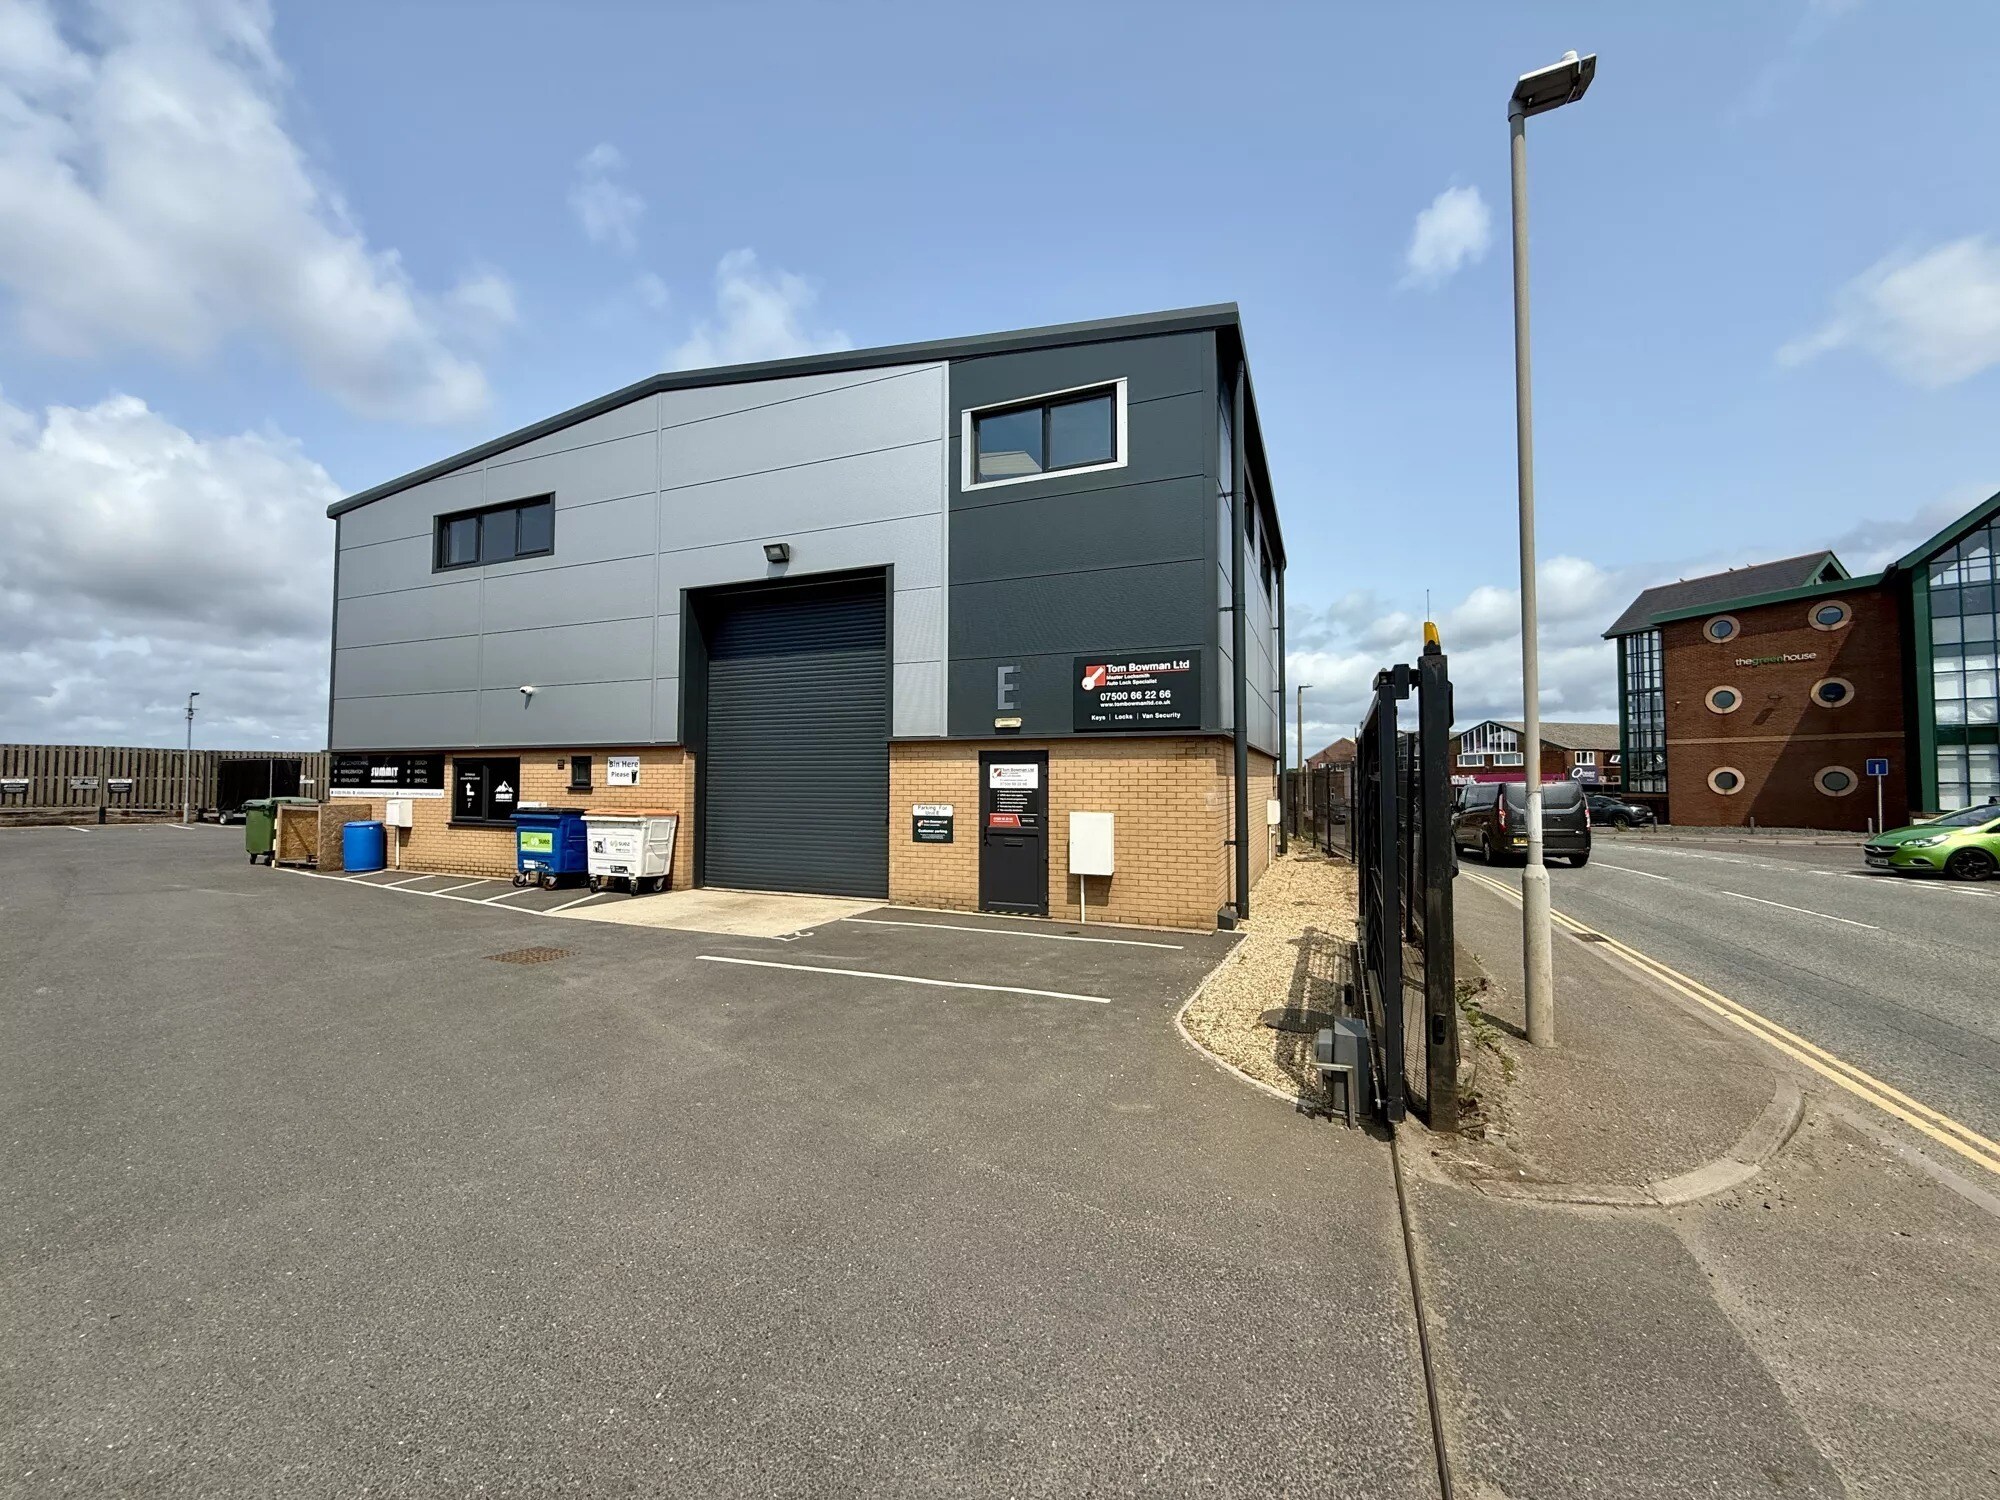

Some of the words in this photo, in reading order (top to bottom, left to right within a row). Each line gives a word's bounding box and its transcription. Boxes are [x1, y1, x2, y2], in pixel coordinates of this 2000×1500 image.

[1735, 652, 1817, 666] thegreenhouse
[1106, 664, 1127, 673] Tom
[1128, 662, 1171, 672] Bowman
[1173, 660, 1190, 669] Ltd
[997, 666, 1021, 709] E
[1099, 692, 1128, 701] 07500
[1130, 691, 1142, 700] 66
[1144, 690, 1157, 699] 22
[1159, 689, 1171, 699] 66
[1100, 700, 1171, 708] www.tombowmanltd.co.uk
[608, 760, 620, 768] Bin
[621, 760, 639, 768] Here
[370, 766, 399, 777] SUMMIT
